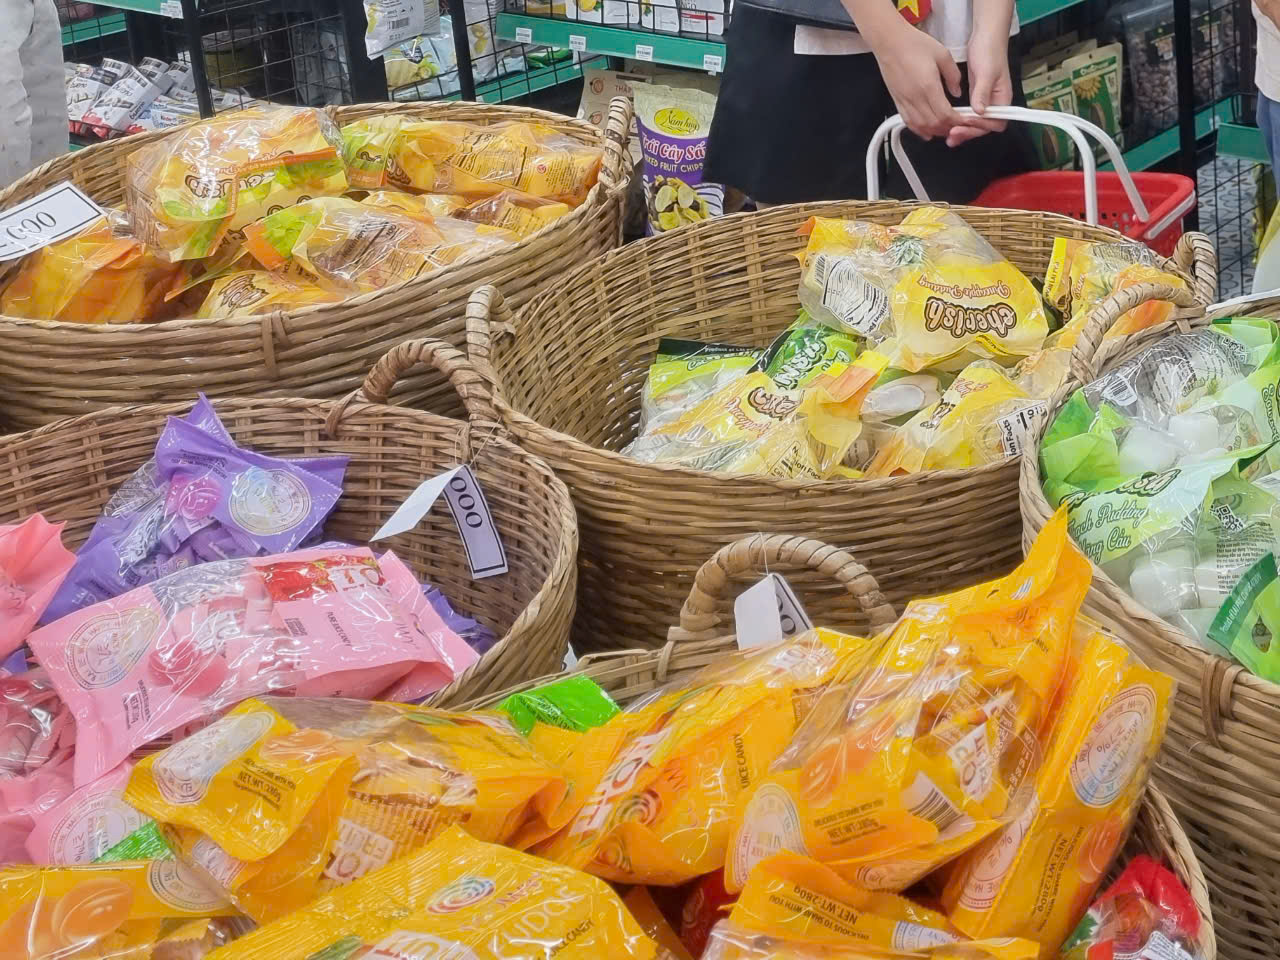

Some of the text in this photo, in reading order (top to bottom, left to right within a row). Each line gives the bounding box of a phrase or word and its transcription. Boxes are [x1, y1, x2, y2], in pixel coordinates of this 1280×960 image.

[685, 139, 706, 159] Sấ
[659, 161, 677, 173] FRUIT
[1097, 500, 1149, 528] Pudding
